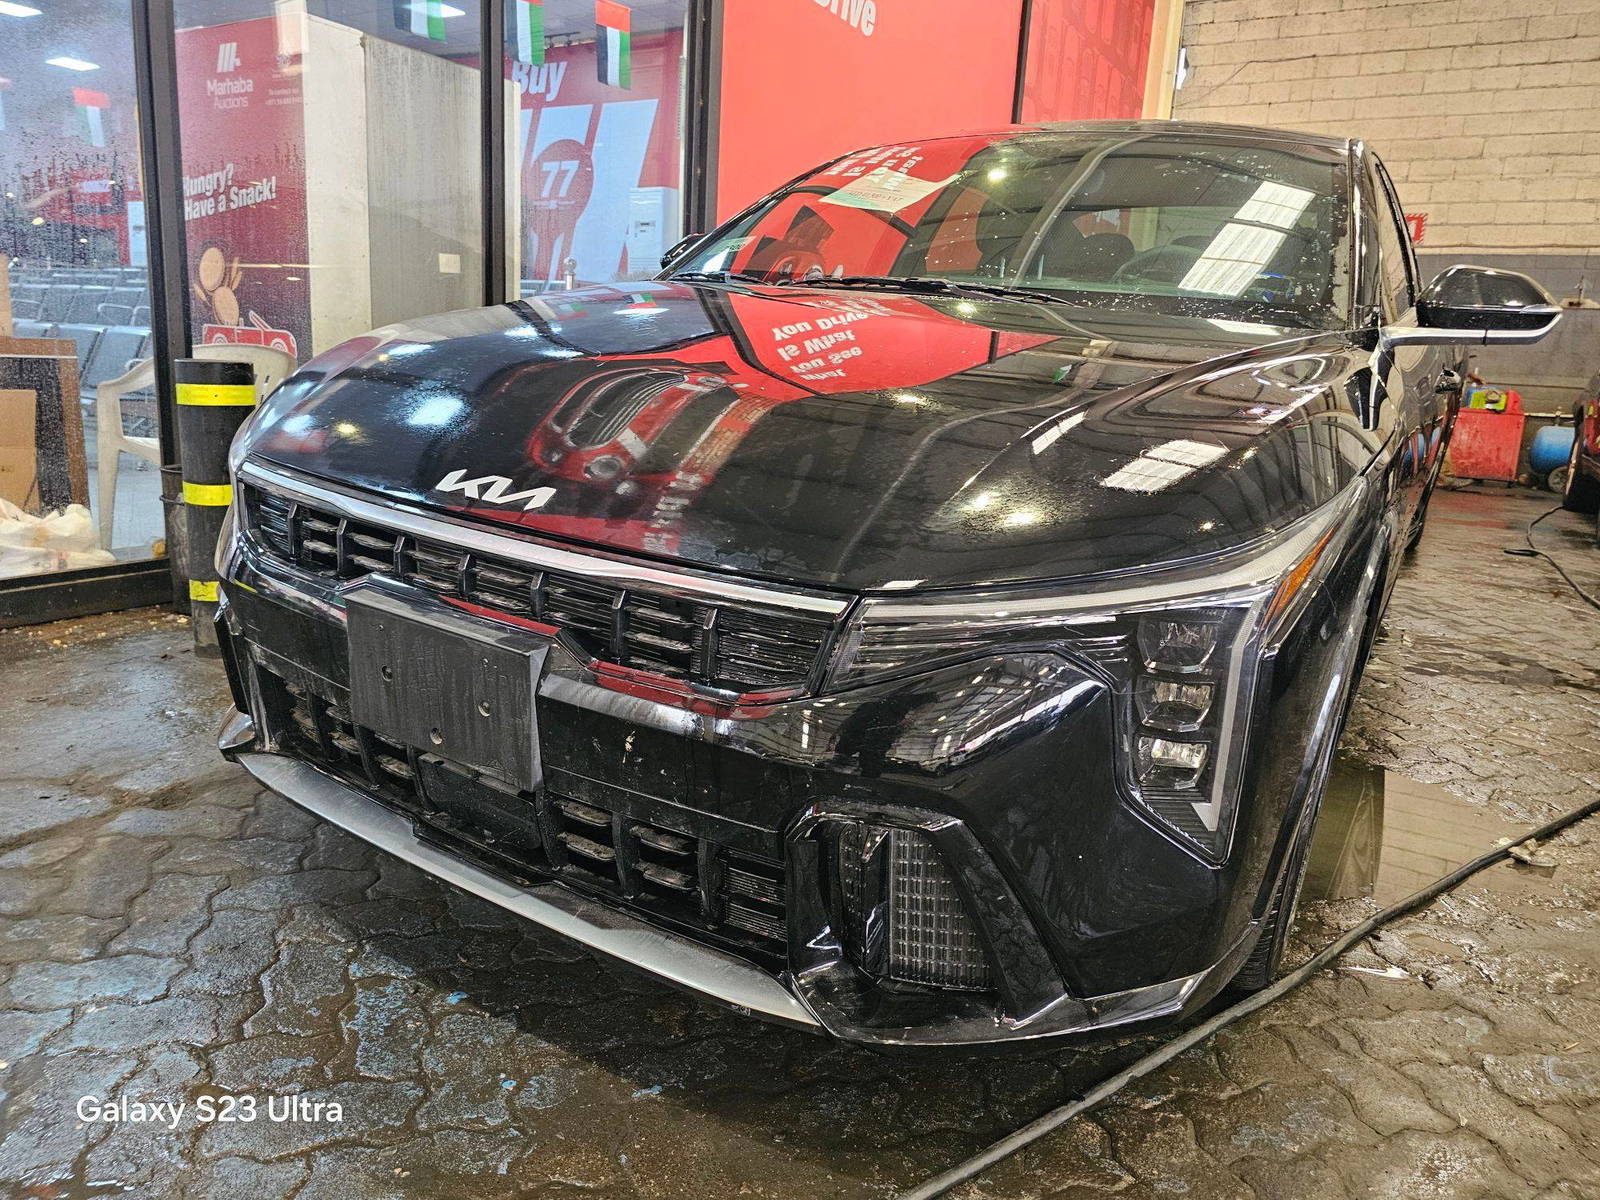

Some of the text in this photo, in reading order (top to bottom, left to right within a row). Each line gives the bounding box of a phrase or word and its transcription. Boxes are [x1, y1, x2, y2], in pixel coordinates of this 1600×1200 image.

[206, 78, 254, 96] Marhaba
[511, 61, 568, 102] Buy
[184, 175, 277, 221] Have a Snack!
[541, 160, 580, 198] 77
[435, 469, 557, 511] KIA
